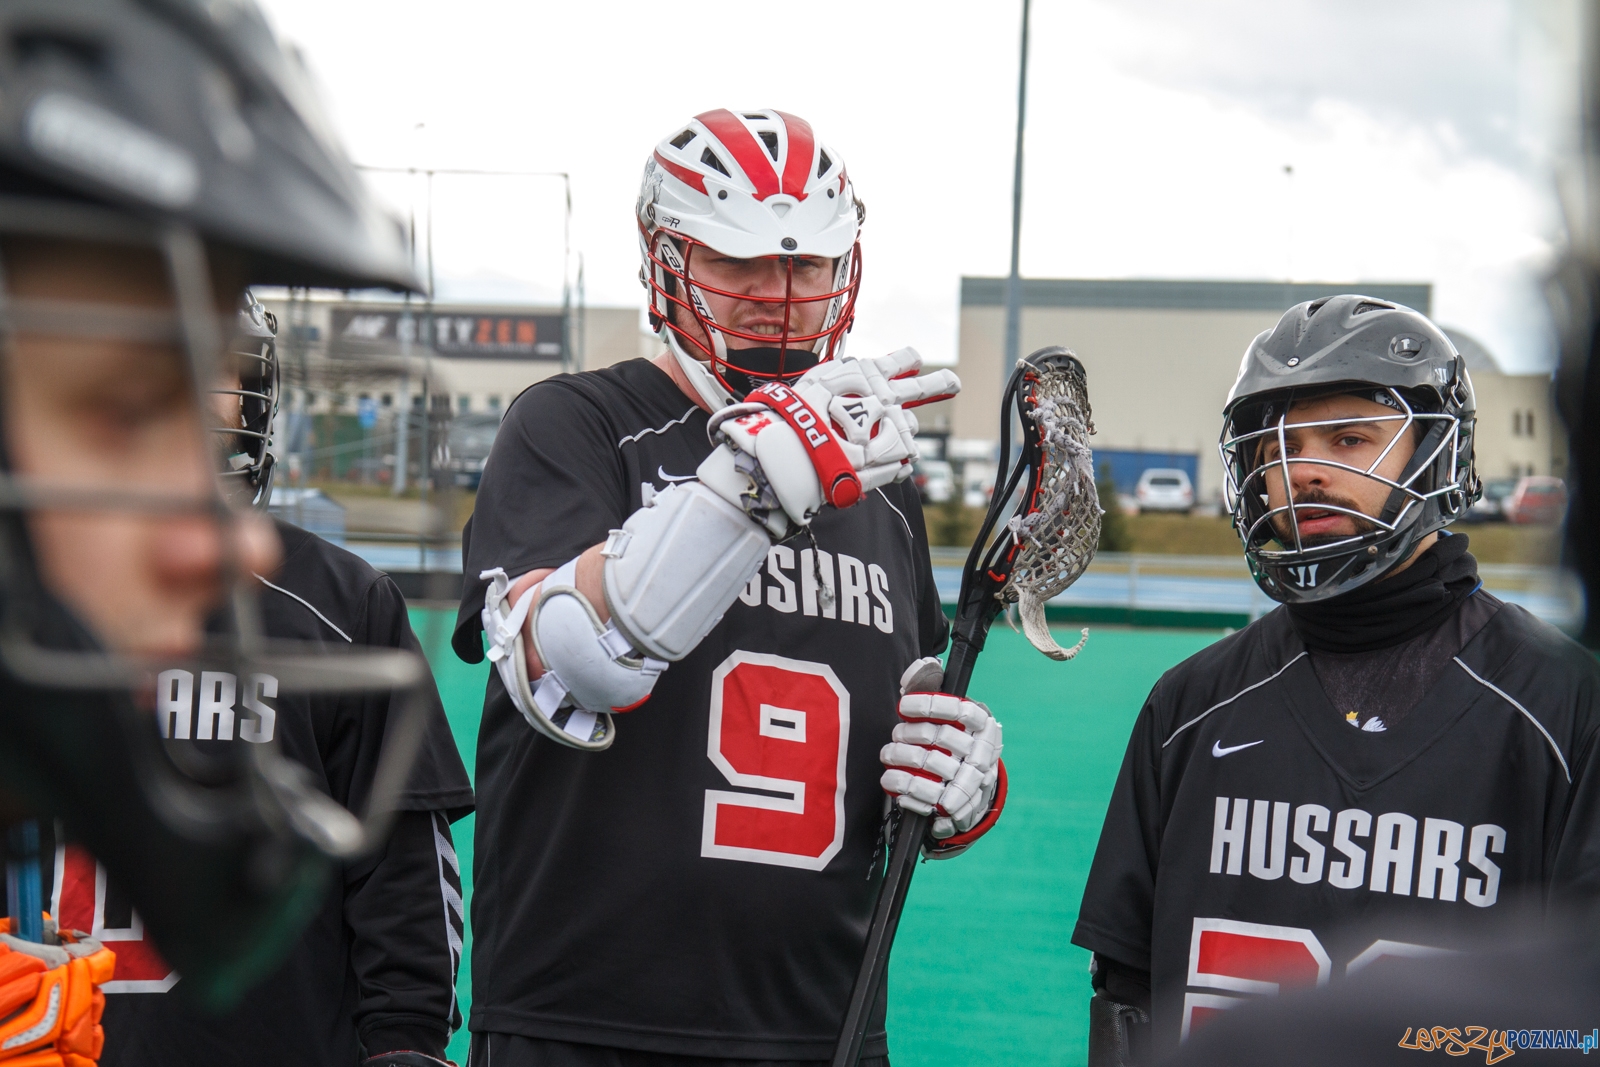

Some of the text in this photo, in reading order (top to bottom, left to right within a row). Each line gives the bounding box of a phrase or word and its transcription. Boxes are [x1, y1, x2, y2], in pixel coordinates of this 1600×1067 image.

[737, 544, 894, 634] SARS
[701, 649, 851, 873] 9
[1209, 796, 1507, 908] HUSSARS
